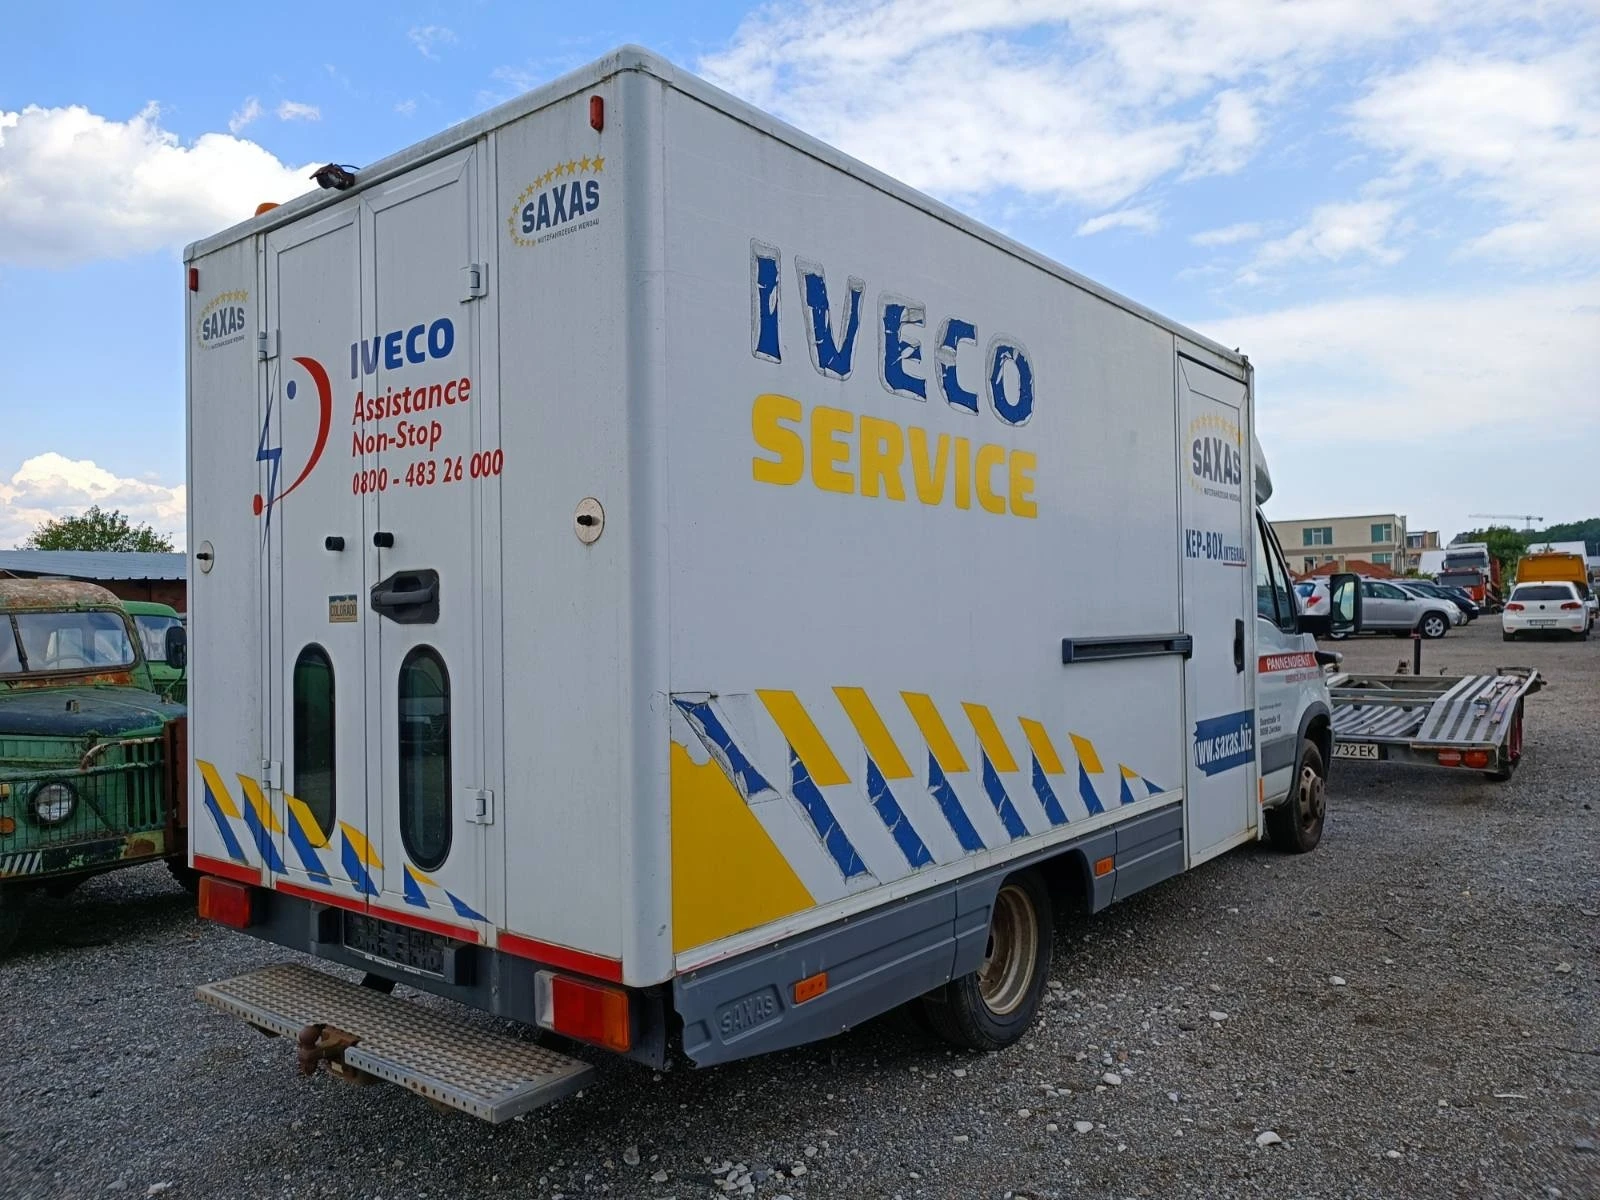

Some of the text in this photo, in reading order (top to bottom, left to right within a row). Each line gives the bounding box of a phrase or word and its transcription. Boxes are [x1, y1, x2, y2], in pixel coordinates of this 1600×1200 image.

[522, 180, 600, 234] SAXAS
[203, 306, 245, 341] SAXAS
[750, 237, 1036, 428] IVECO
[350, 317, 455, 380] IVECO
[352, 377, 471, 425] Assistance
[352, 420, 442, 457] Non-Stop
[751, 393, 1038, 518] SERVICE
[1192, 436, 1242, 485] SAXAS
[352, 467, 388, 496] 0800
[405, 460, 436, 488] 483
[442, 455, 463, 483] 26
[469, 448, 504, 480] 000
[1185, 528, 1224, 562] KEP-BOX
[1359, 744, 1376, 758] EK
[719, 995, 774, 1036] SAXAS
